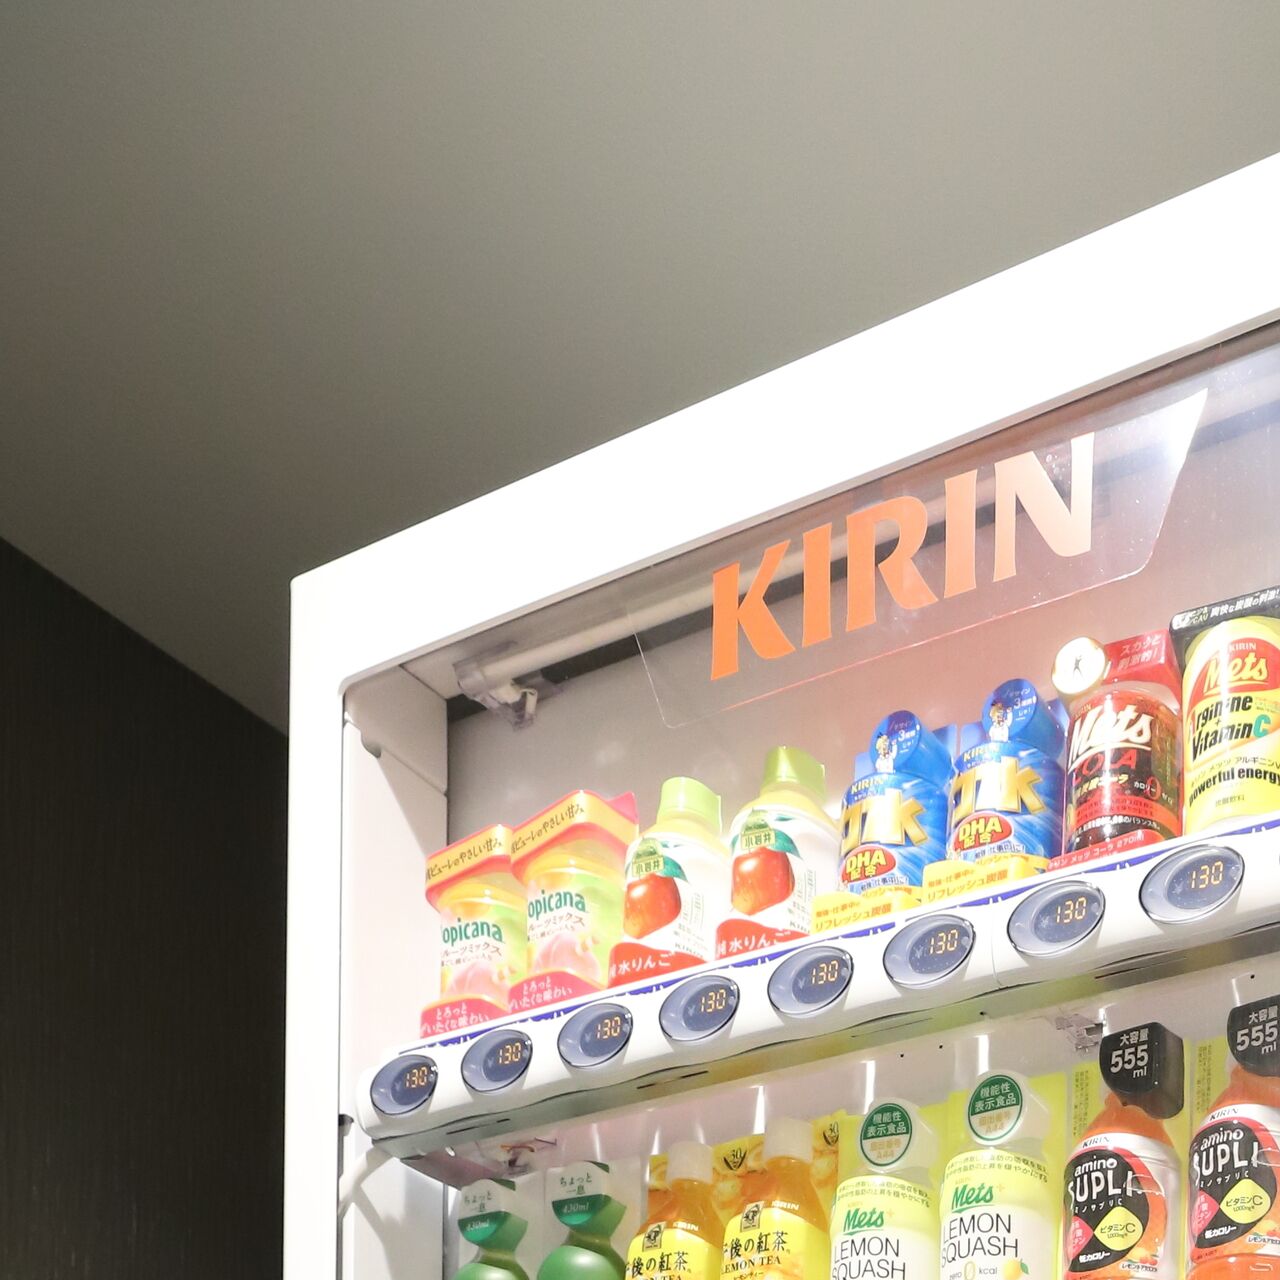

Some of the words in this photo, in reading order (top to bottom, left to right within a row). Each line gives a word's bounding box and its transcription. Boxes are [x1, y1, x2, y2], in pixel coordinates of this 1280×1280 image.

[710, 431, 1095, 681] KIRIN
[1203, 651, 1269, 695] Mets
[1068, 703, 1154, 774] Mets
[744, 832, 773, 847] 小岩井
[958, 816, 1003, 841] DHA
[635, 858, 661, 875] 小岩井
[846, 849, 887, 874] DHA
[1190, 860, 1223, 889] 130
[927, 869, 1008, 902] リフレッシュ炭酸
[815, 903, 892, 933] リフレッシュ炭酸
[1055, 897, 1087, 924] 130
[928, 929, 960, 956] 130
[811, 960, 840, 986] 130
[700, 988, 727, 1014] 130
[1248, 1005, 1278, 1024] 大容量
[597, 1016, 622, 1040] 130
[1120, 1028, 1149, 1047] 大容量
[1236, 1021, 1278, 1051] 555
[498, 1041, 523, 1066] 130
[1110, 1045, 1149, 1073] 555
[404, 1065, 428, 1089] 130
[974, 1092, 1017, 1111] 表示食品
[867, 1120, 907, 1136] 表示食品
[872, 1111, 902, 1123] 機能性
[1200, 1127, 1244, 1149] amino
[1074, 1154, 1118, 1176] amino
[951, 1181, 994, 1213] Mets
[843, 1207, 885, 1235] Mets
[942, 1213, 1012, 1245] LEMON
[833, 1236, 900, 1264] LEMON
[941, 1236, 1019, 1265] SQUASH
